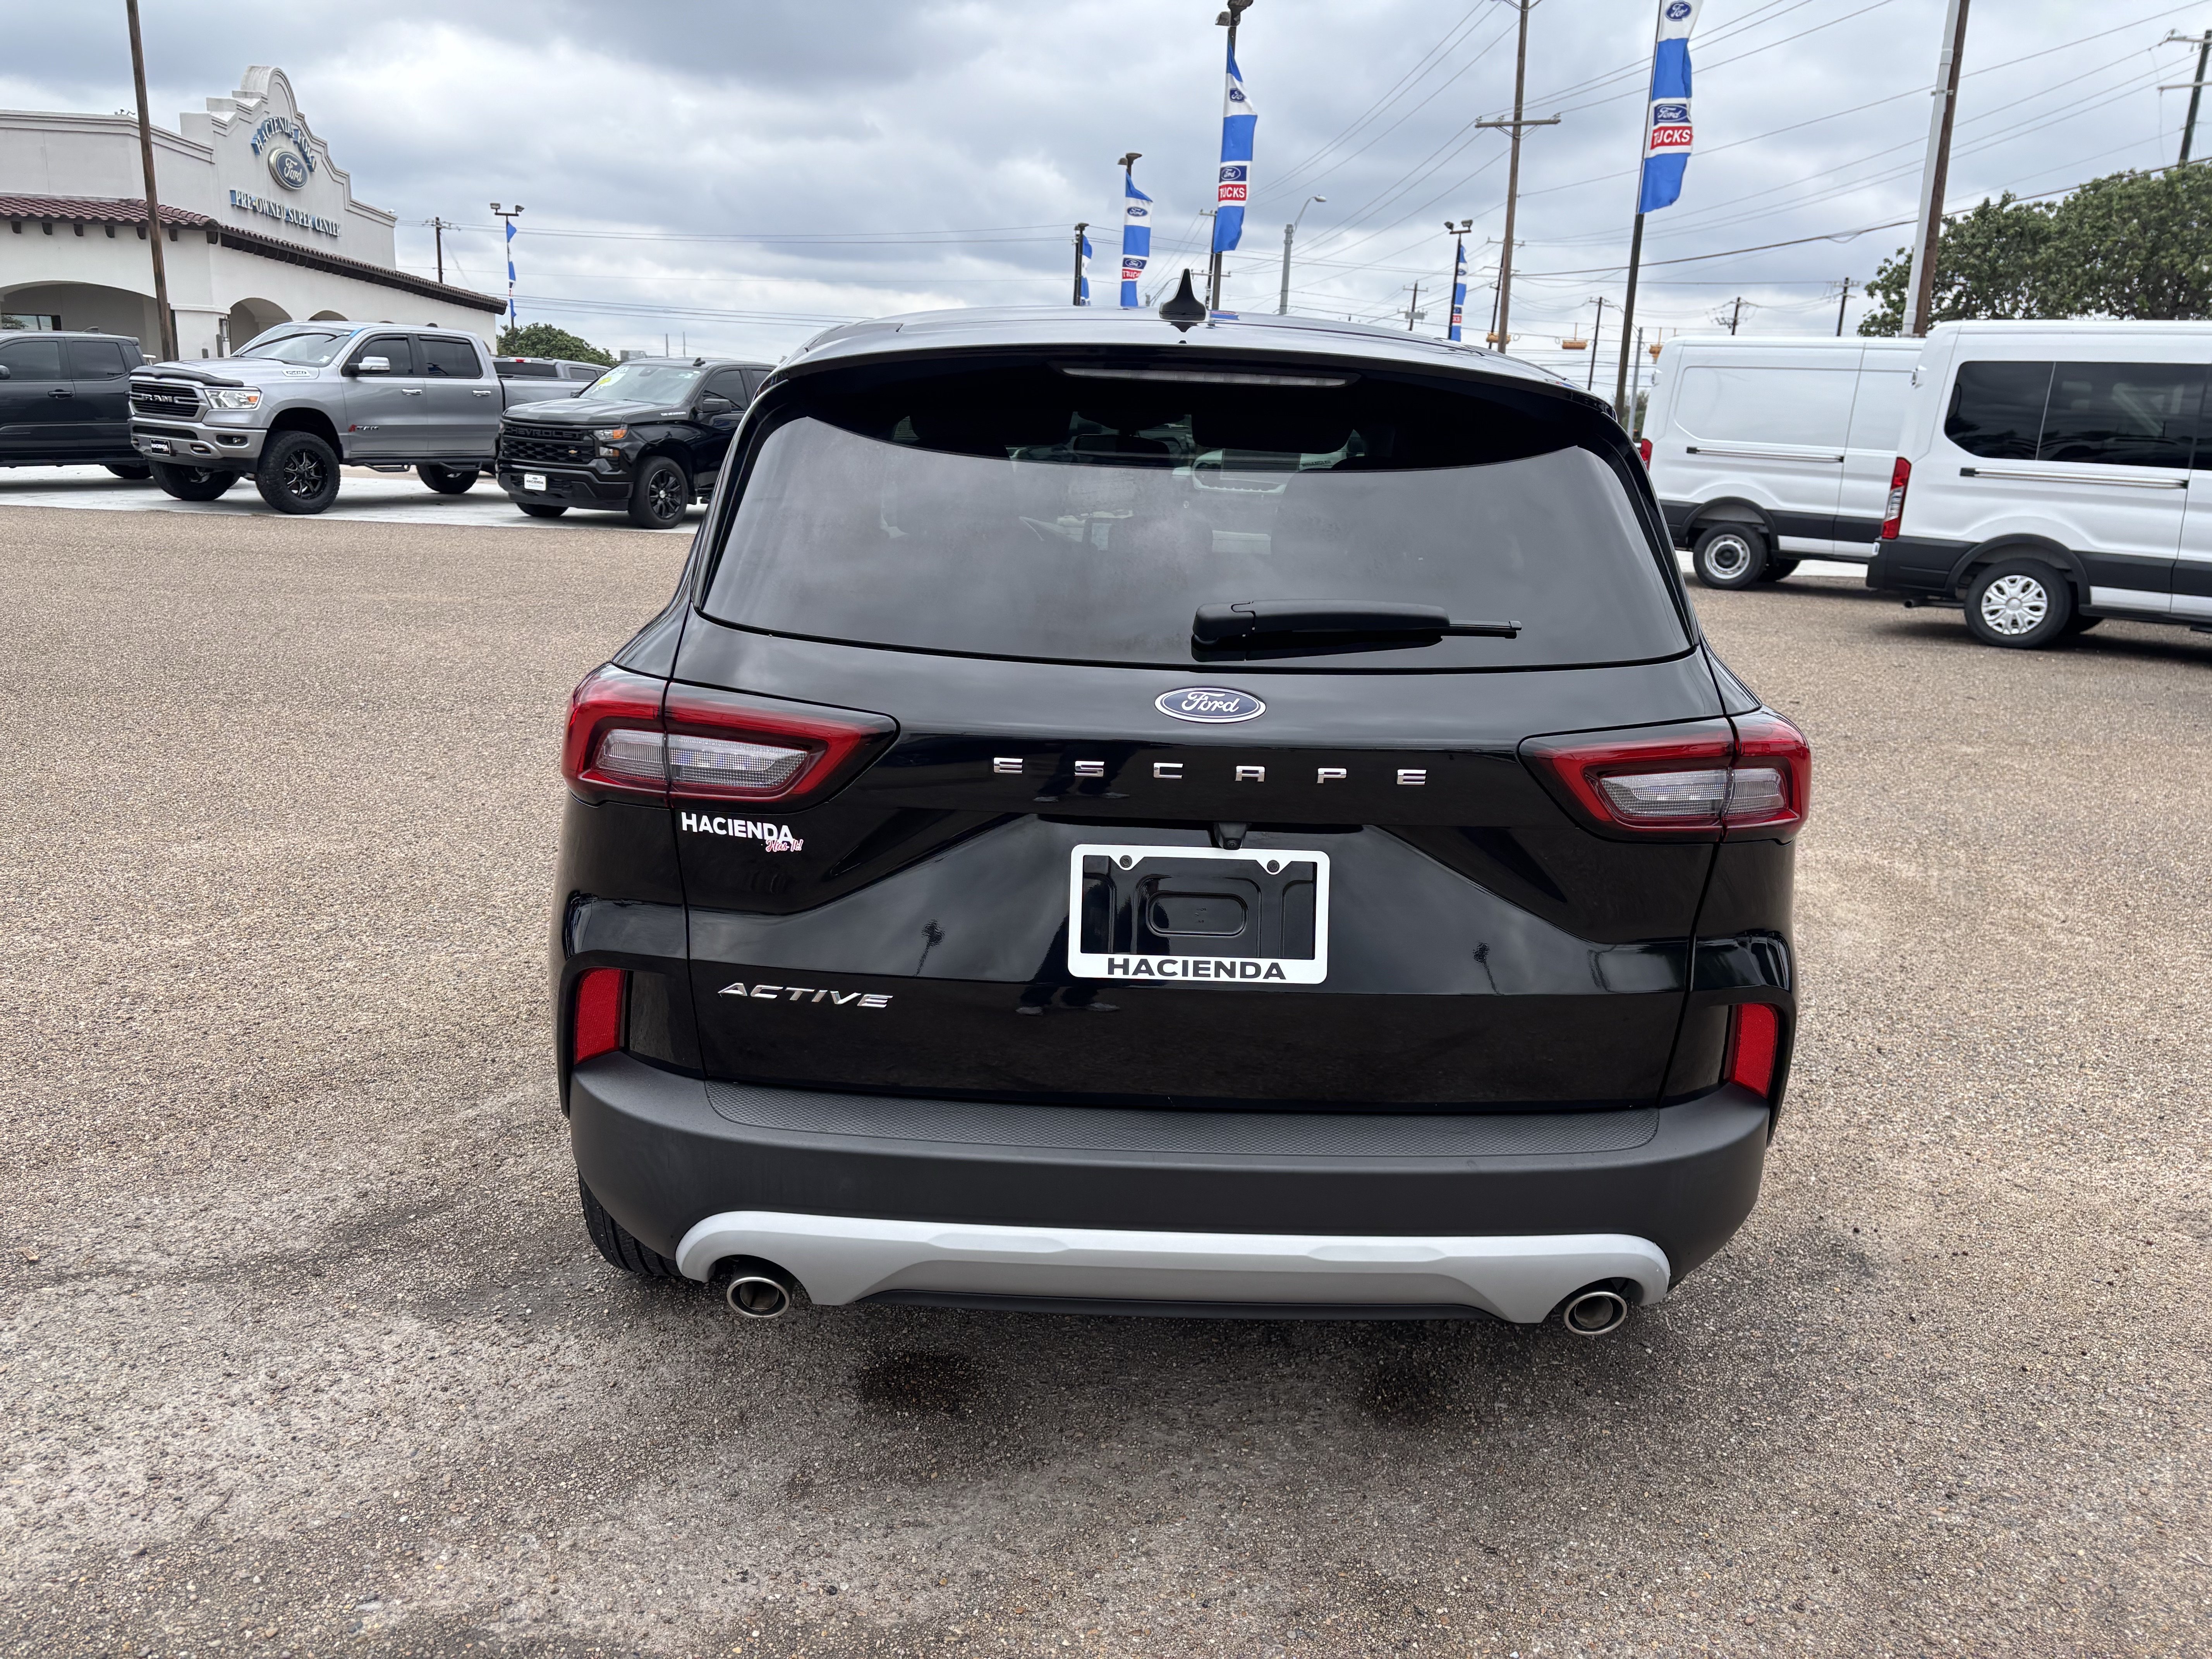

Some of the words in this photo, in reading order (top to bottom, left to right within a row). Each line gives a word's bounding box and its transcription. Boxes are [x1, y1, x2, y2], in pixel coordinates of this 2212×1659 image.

[1670, 3, 1688, 17] For
[1654, 129, 1691, 145] TUCKS
[284, 158, 302, 182] Ford
[1219, 187, 1245, 198] TUCKS
[230, 190, 286, 220] PRE-OWNED
[288, 208, 313, 228] SUPER
[142, 393, 173, 402] RAM
[505, 426, 582, 439] CHEVROLET
[1182, 692, 1240, 712] Ford
[993, 757, 1427, 785] ESCAPE
[681, 812, 795, 843] HACIENDA
[765, 839, 789, 852] Has
[790, 838, 804, 852] It!
[1108, 958, 1286, 980] HACIENDA
[718, 982, 893, 1008] ACTIVE
